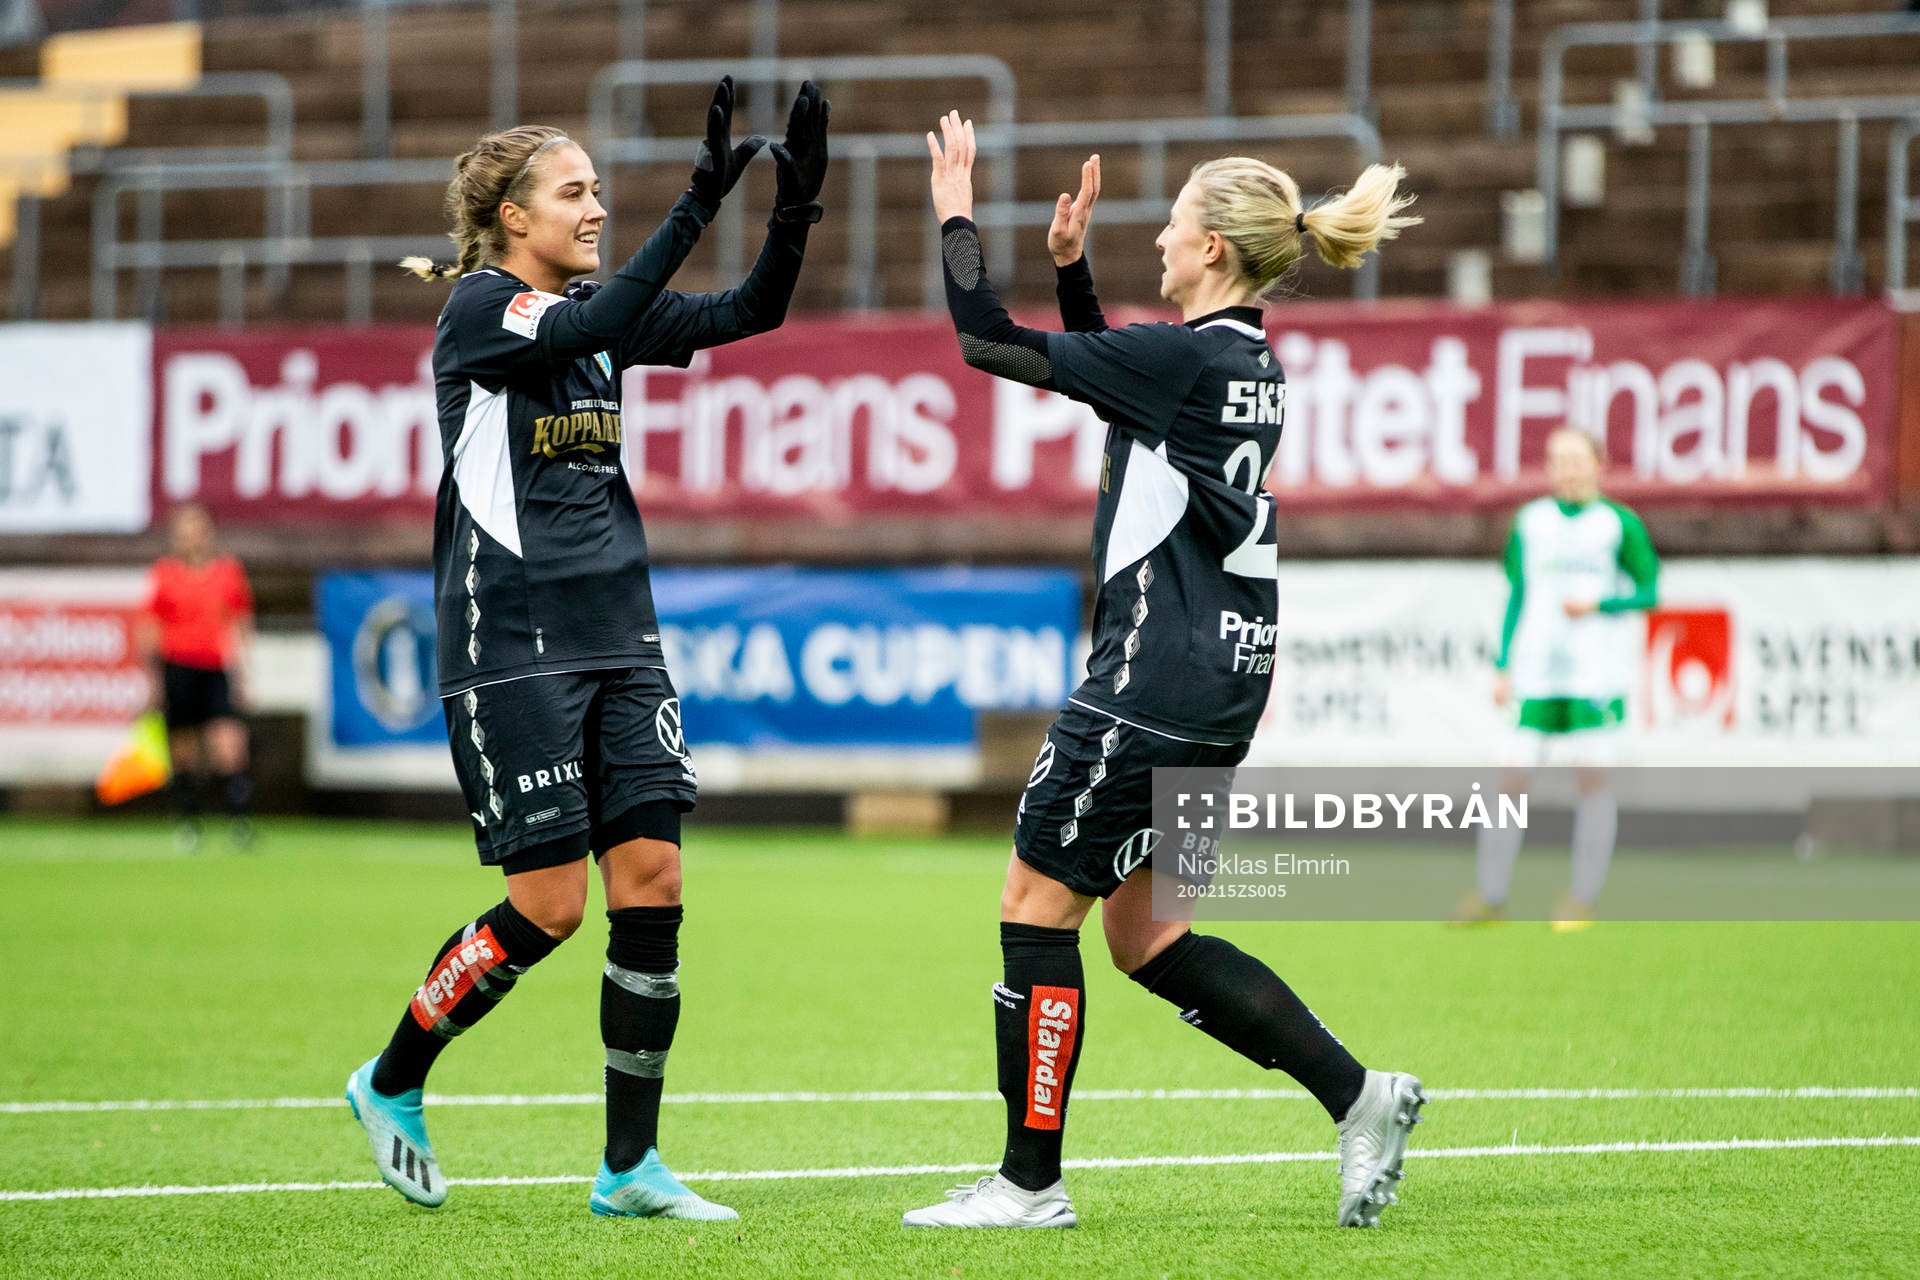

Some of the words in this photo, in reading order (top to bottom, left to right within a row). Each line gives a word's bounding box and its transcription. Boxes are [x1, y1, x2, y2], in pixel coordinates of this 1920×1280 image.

[1497, 328, 1867, 484] Finans
[801, 622, 1066, 710] CUPEN
[1033, 998, 1072, 1117] Stavdal
